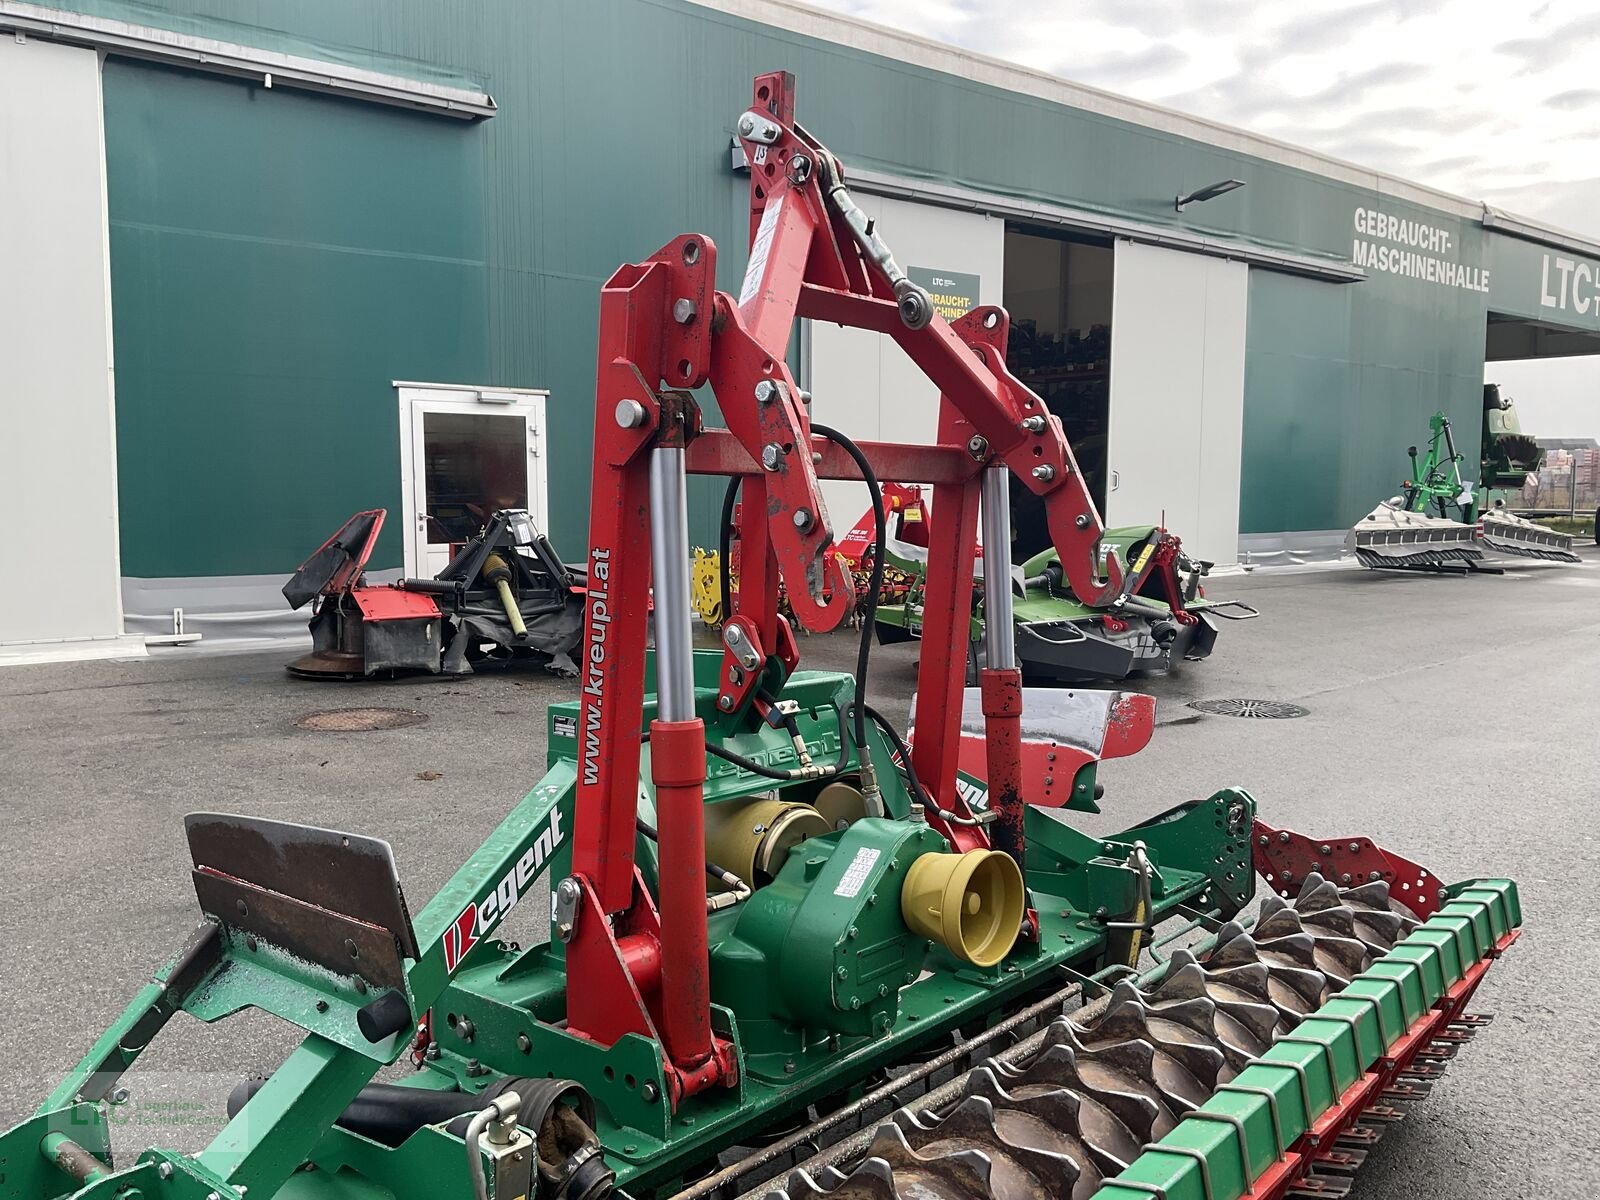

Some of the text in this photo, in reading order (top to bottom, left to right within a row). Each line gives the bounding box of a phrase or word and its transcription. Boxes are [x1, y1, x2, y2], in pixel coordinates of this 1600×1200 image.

[1354, 207, 1452, 253] GEBRAUCHT-
[932, 277, 944, 287] LTC
[1353, 239, 1490, 292] MASCHINENHALLE
[1541, 255, 1592, 314] LTC
[583, 547, 611, 786] www.kreupl.at
[443, 805, 564, 975] Regent
